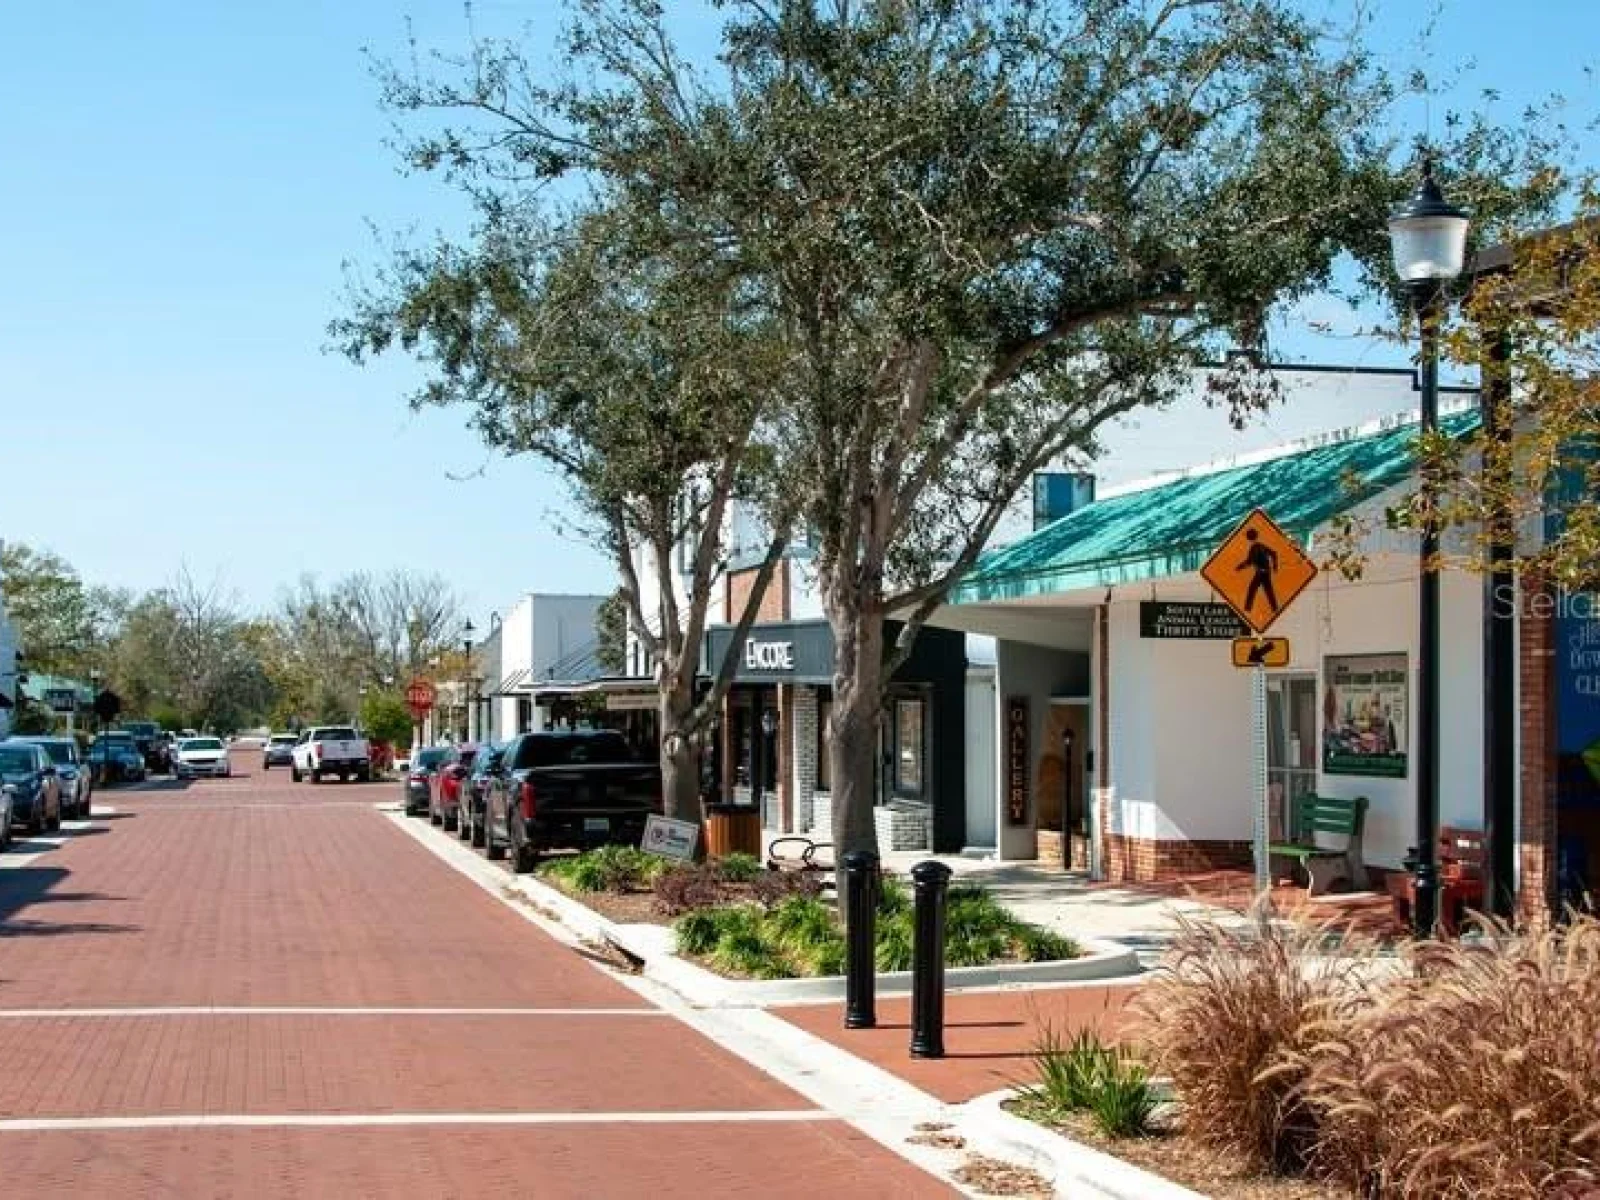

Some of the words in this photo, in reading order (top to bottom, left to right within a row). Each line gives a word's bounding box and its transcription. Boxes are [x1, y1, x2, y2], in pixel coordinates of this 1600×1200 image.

[745, 638, 794, 670] ENCORE
[408, 688, 434, 704] STOP
[1012, 707, 1024, 820] GALLERY
